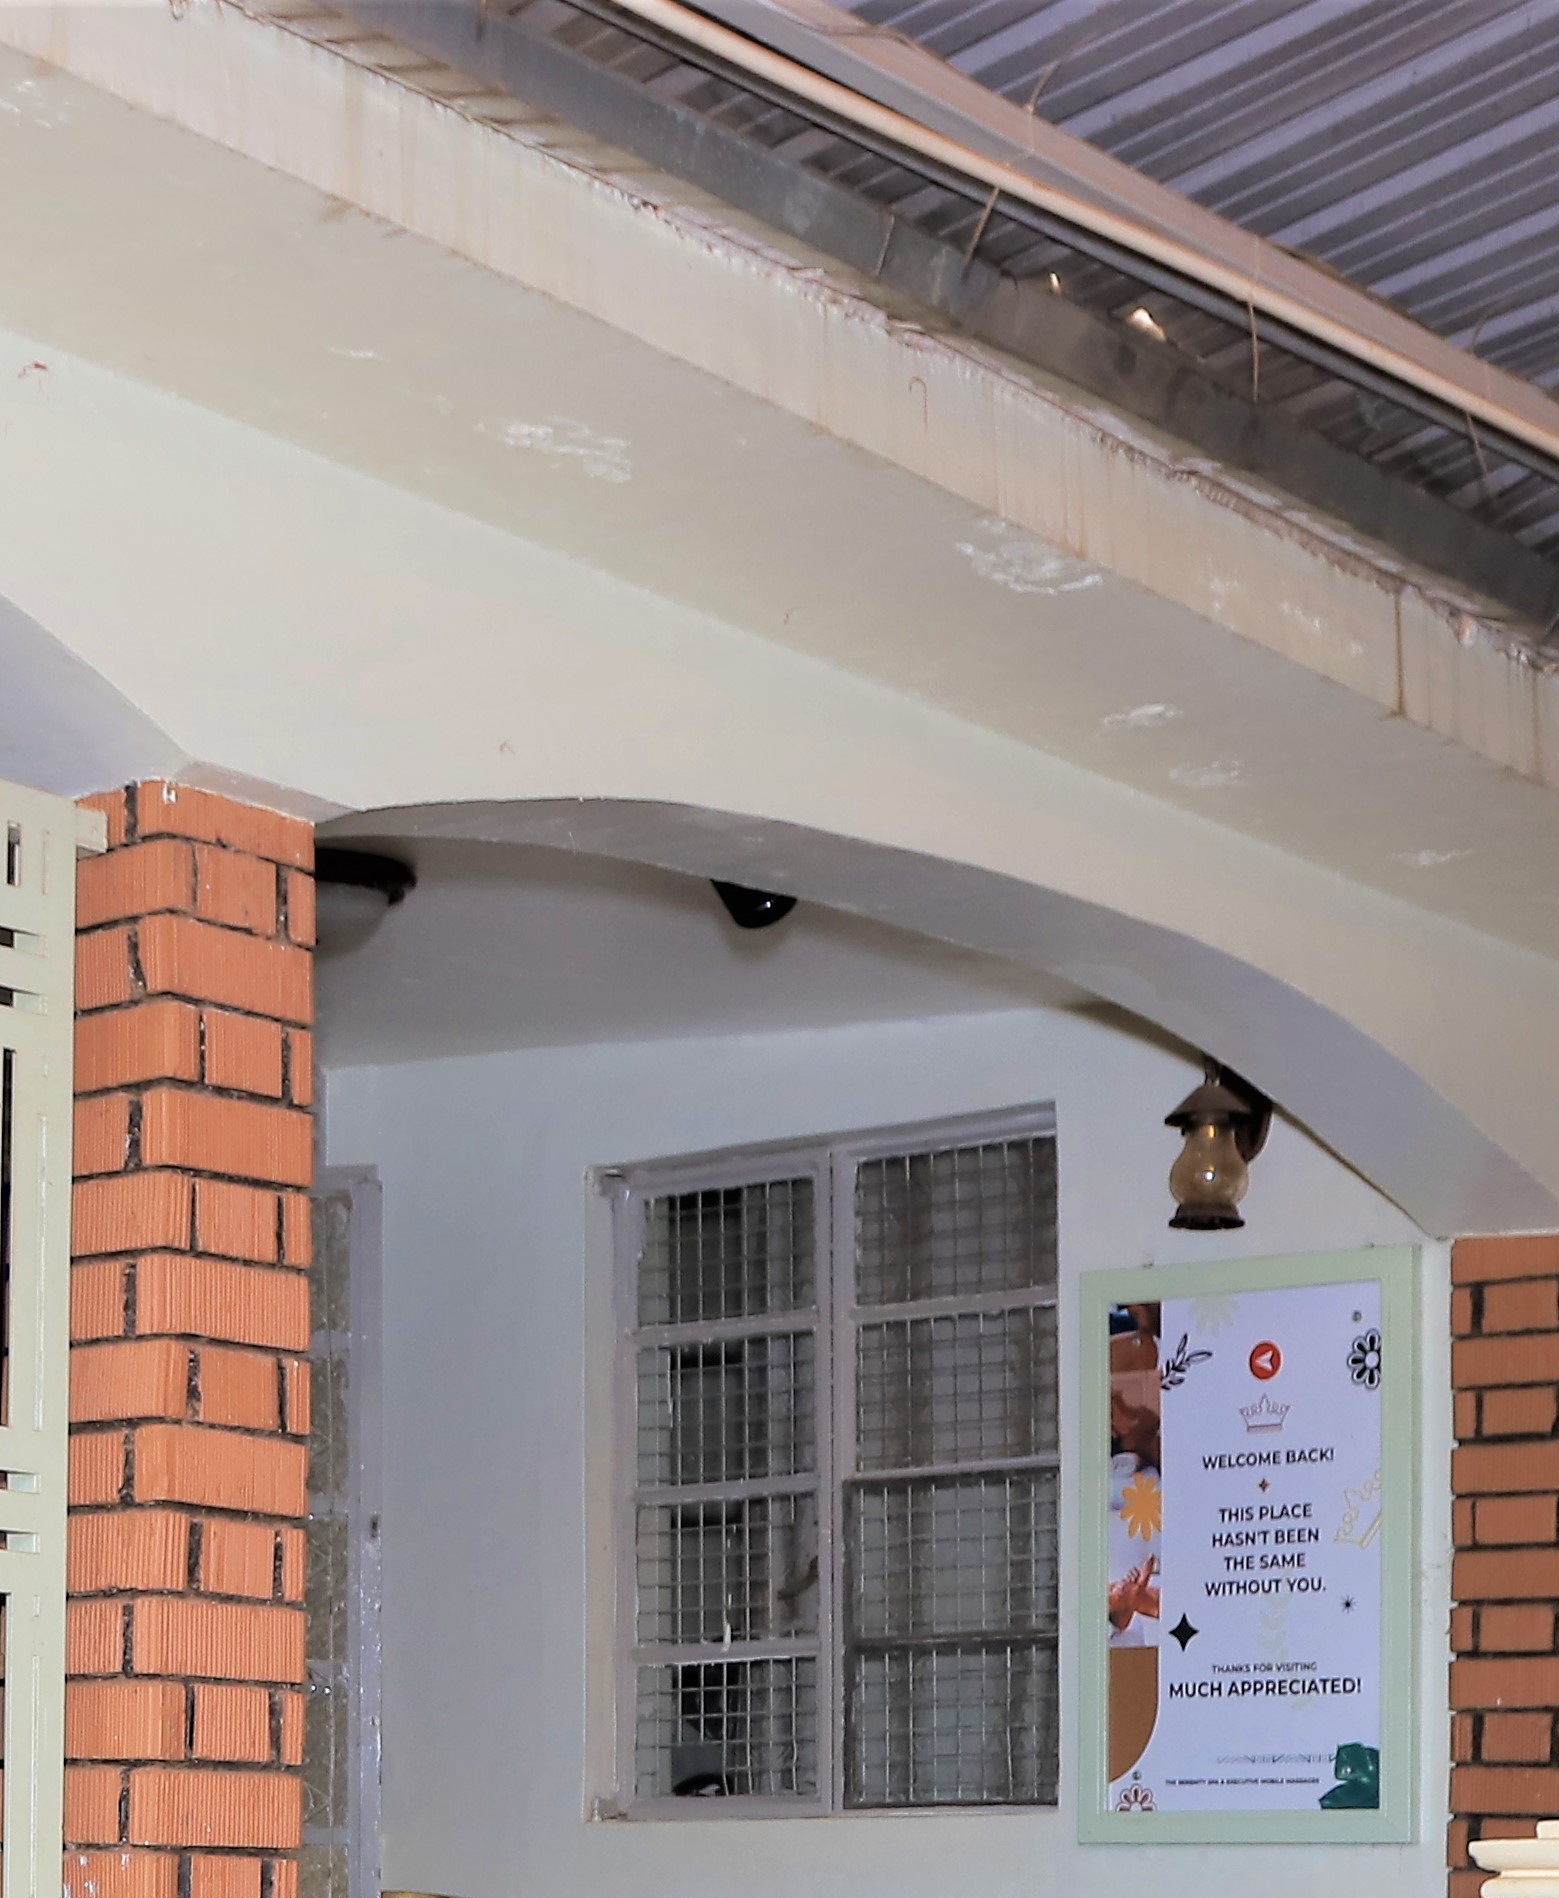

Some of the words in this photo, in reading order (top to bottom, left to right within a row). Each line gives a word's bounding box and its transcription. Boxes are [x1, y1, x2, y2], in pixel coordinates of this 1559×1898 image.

[1202, 1451, 1280, 1470] WELCOME
[1286, 1448, 1334, 1464] BACK!
[1219, 1507, 1254, 1523] THIS
[1259, 1503, 1312, 1520] PLACE
[1212, 1531, 1269, 1548] HASN'T
[1274, 1528, 1319, 1544] BEEN
[1224, 1555, 1254, 1572] THE
[1260, 1553, 1306, 1569] SAME
[1205, 1578, 1281, 1597] WITHOUT
[1286, 1576, 1326, 1592] YOU.
[1212, 1664, 1251, 1674] THANKS
[1253, 1663, 1273, 1673] FOR
[1275, 1661, 1317, 1672] VISITING
[1169, 1681, 1222, 1699] MUCH
[1227, 1677, 1361, 1697] APPRECIATED!
